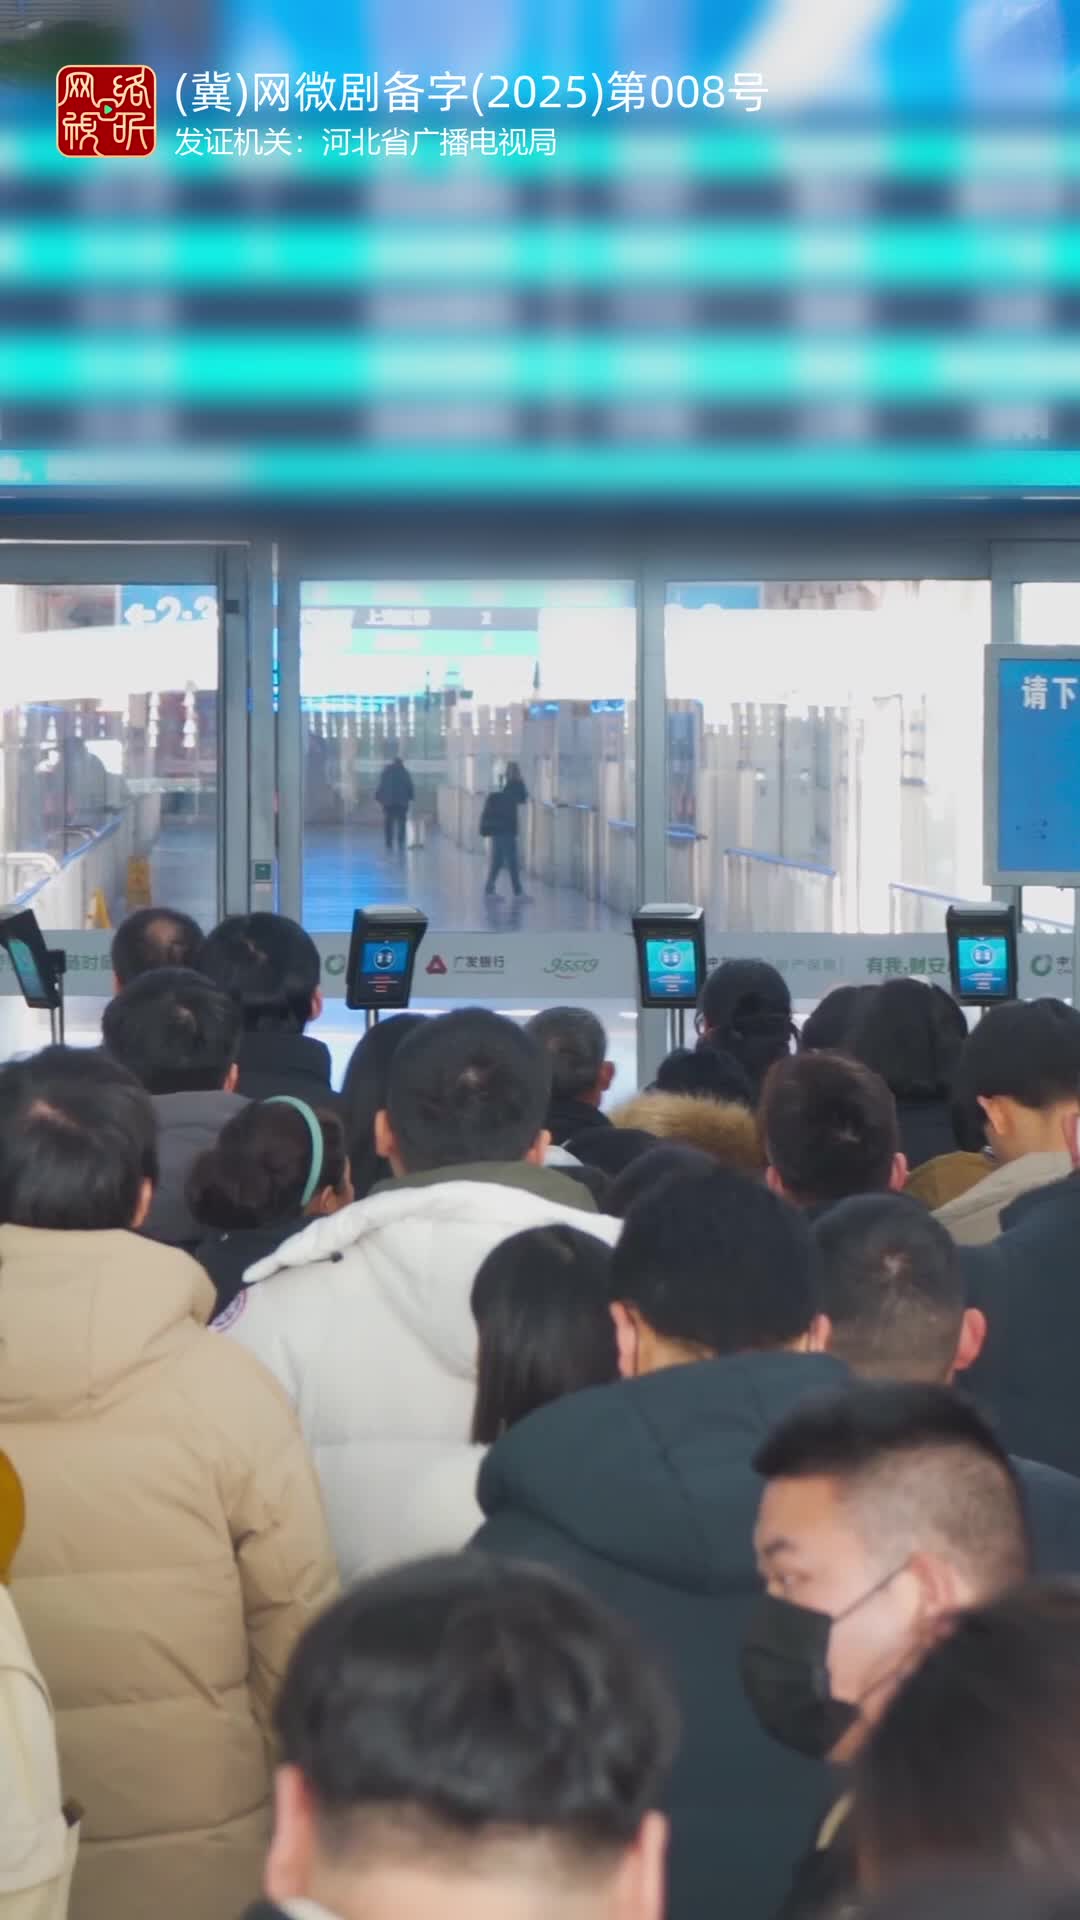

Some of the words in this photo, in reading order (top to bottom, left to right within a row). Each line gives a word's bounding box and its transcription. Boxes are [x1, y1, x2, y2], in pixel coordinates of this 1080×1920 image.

[1021, 675, 1078, 710] 请下
[453, 955, 505, 969] 广发银行
